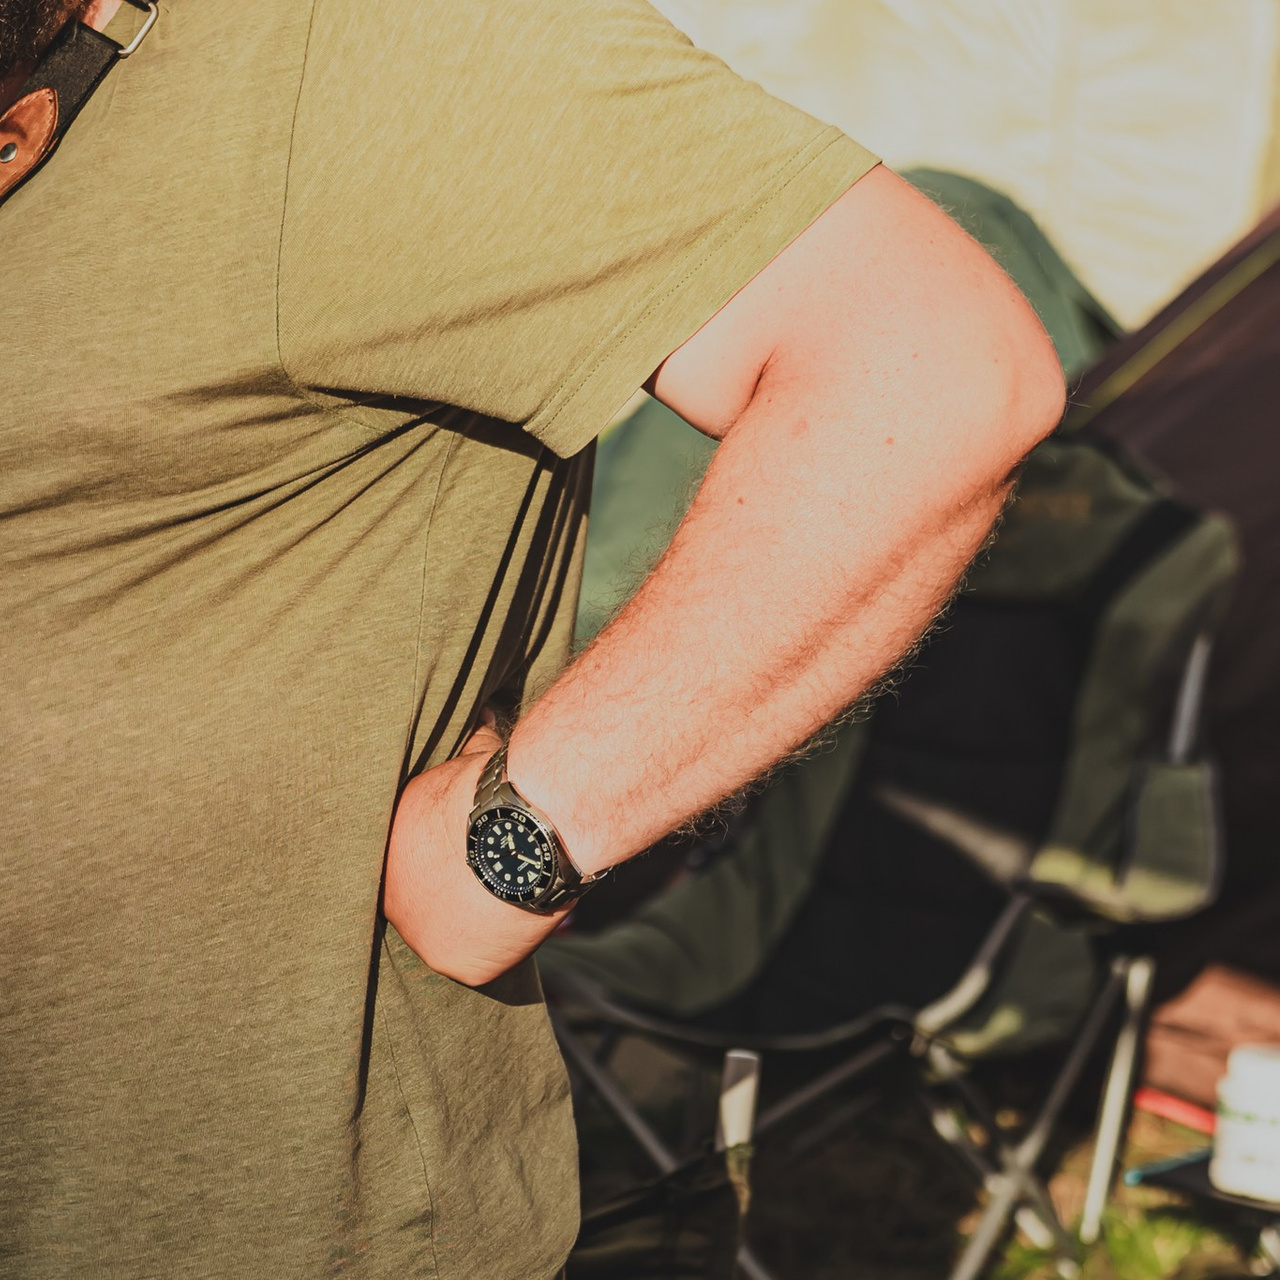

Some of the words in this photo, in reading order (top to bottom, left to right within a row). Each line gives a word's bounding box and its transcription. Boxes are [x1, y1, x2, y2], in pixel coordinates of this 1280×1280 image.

[476, 814, 488, 828] 30
[510, 811, 526, 824] 40
[541, 843, 551, 861] 50
